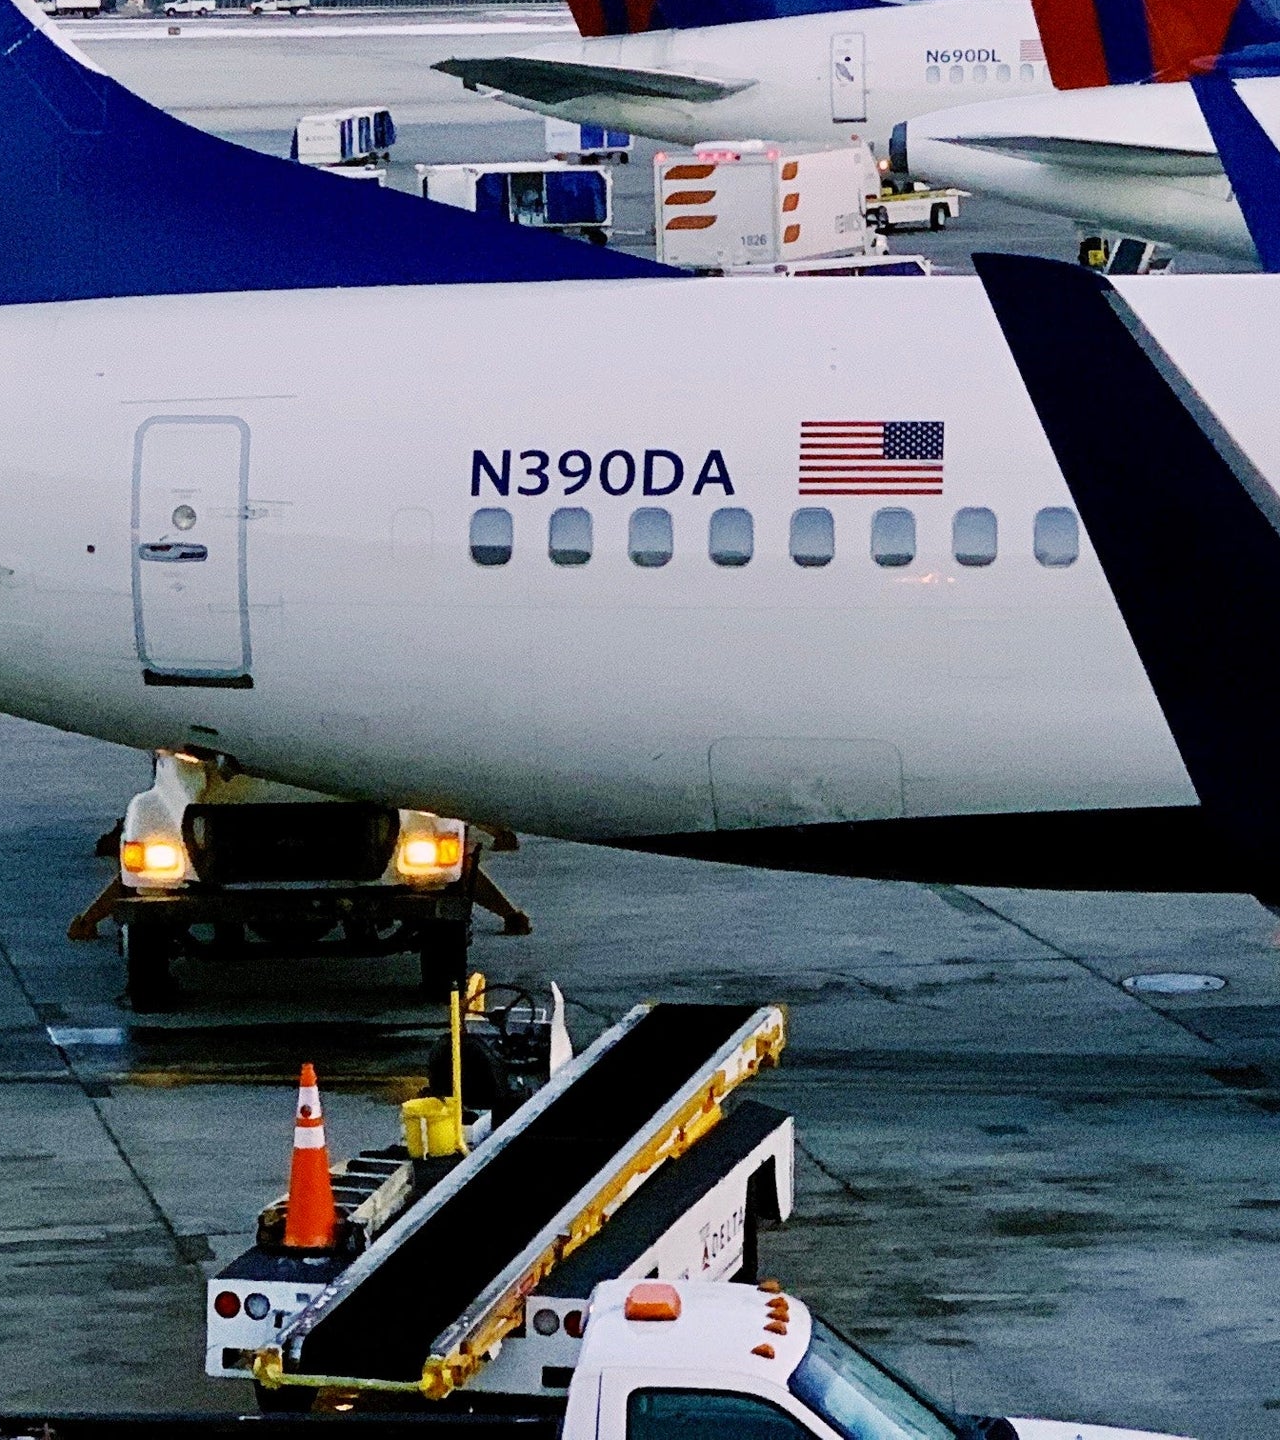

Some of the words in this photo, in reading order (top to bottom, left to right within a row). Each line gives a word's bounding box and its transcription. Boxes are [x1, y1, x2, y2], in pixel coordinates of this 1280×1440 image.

[926, 49, 1002, 63] N690DL
[470, 449, 736, 497] N390DA
[712, 1206, 744, 1258] DELTA
